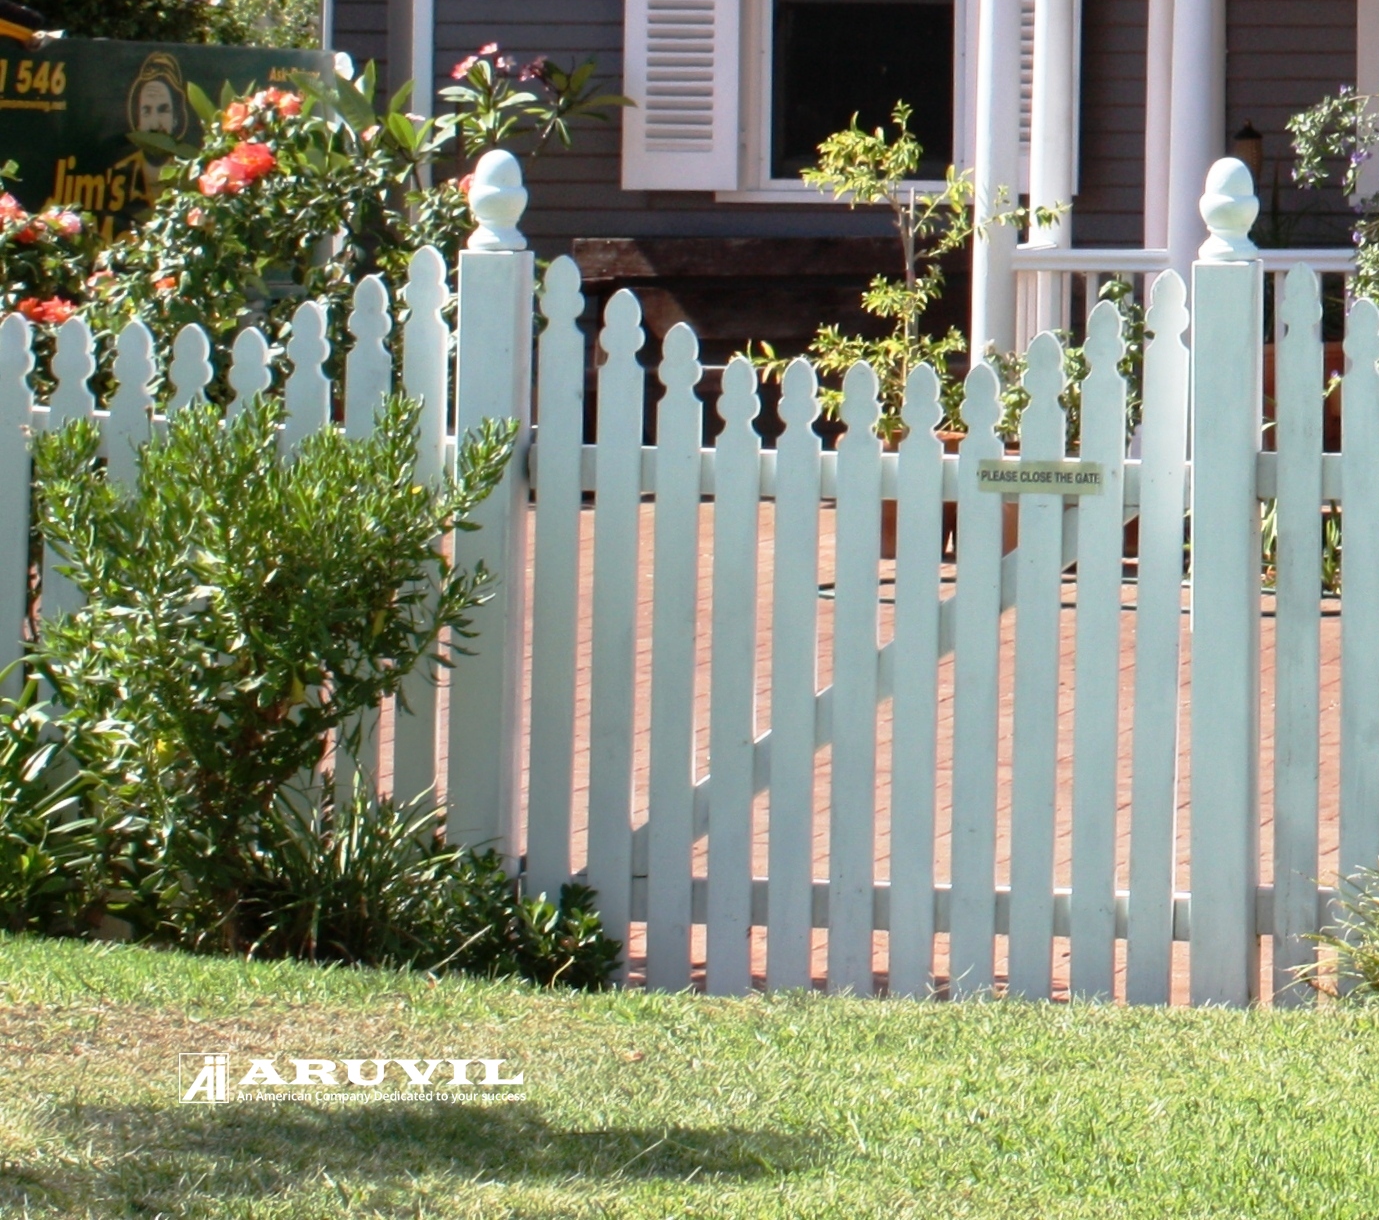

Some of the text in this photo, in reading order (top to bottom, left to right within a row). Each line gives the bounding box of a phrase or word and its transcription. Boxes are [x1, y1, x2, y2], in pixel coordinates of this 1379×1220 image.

[15, 59, 67, 95] 546
[42, 155, 126, 212] Jim's
[981, 470, 1100, 485] PLEASE CLOSE THE GATE
